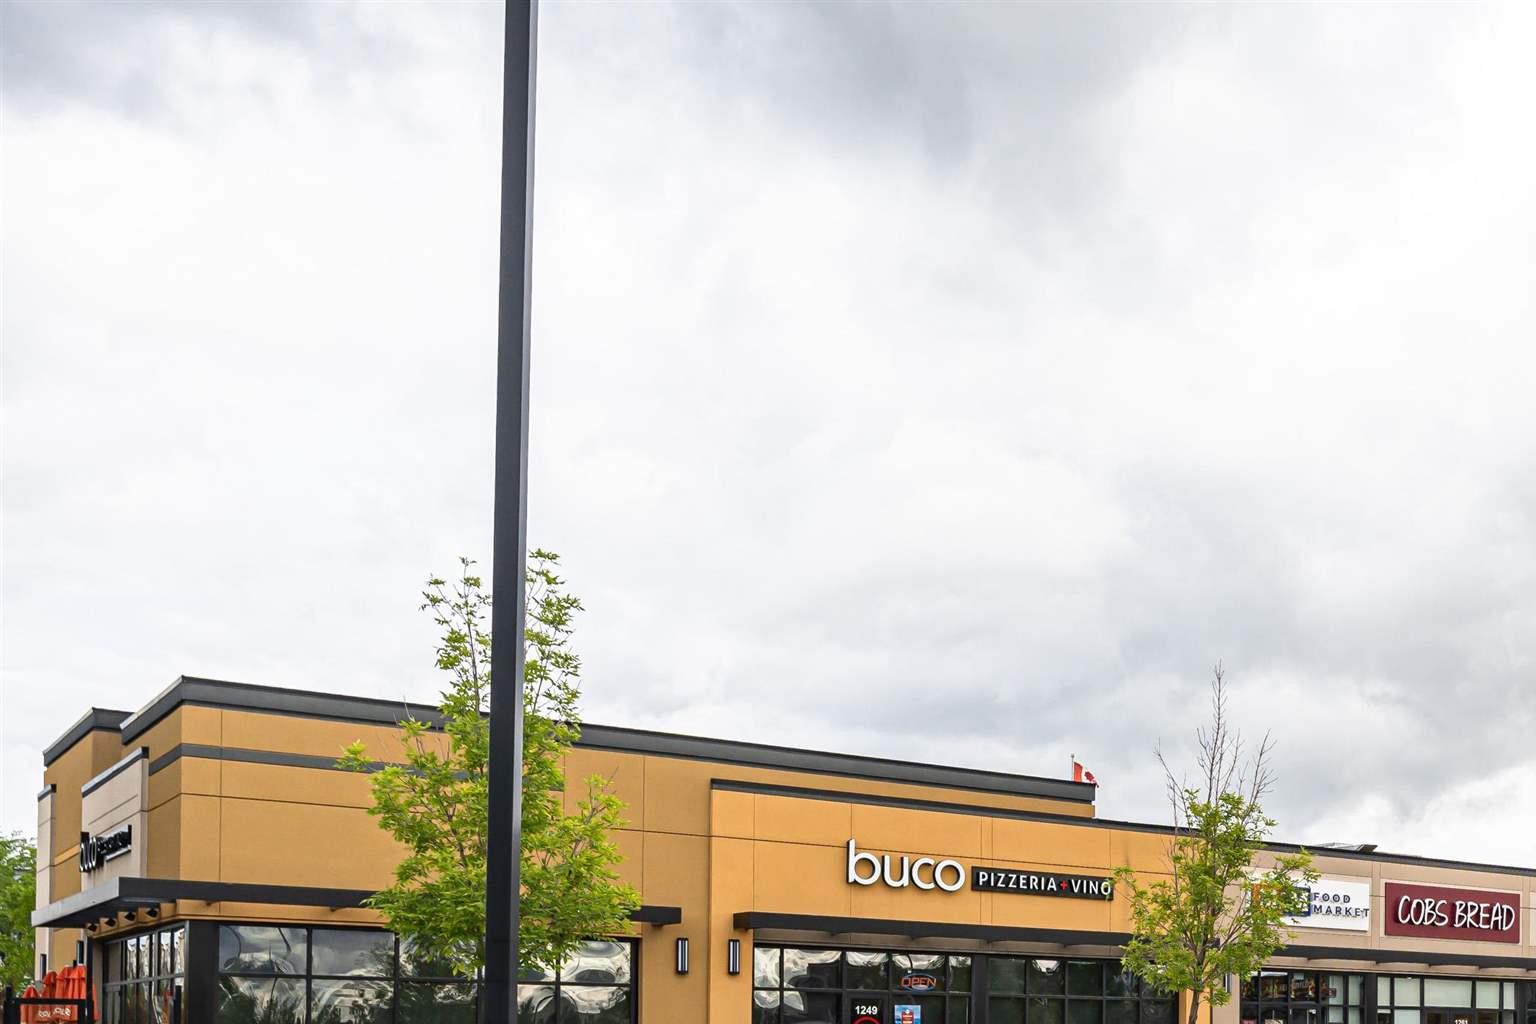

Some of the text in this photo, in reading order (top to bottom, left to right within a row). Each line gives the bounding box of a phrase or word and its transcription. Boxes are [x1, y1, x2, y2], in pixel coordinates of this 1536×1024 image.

[848, 839, 966, 892] buco
[979, 871, 1057, 891] PIZZERIA
[1071, 879, 1111, 896] VINO
[1313, 892, 1351, 903] FOOD
[1313, 905, 1369, 917] MARKET
[1398, 895, 1515, 931] COBS BREAD
[901, 977, 937, 988] OPEN
[855, 1005, 878, 1015] 1249
